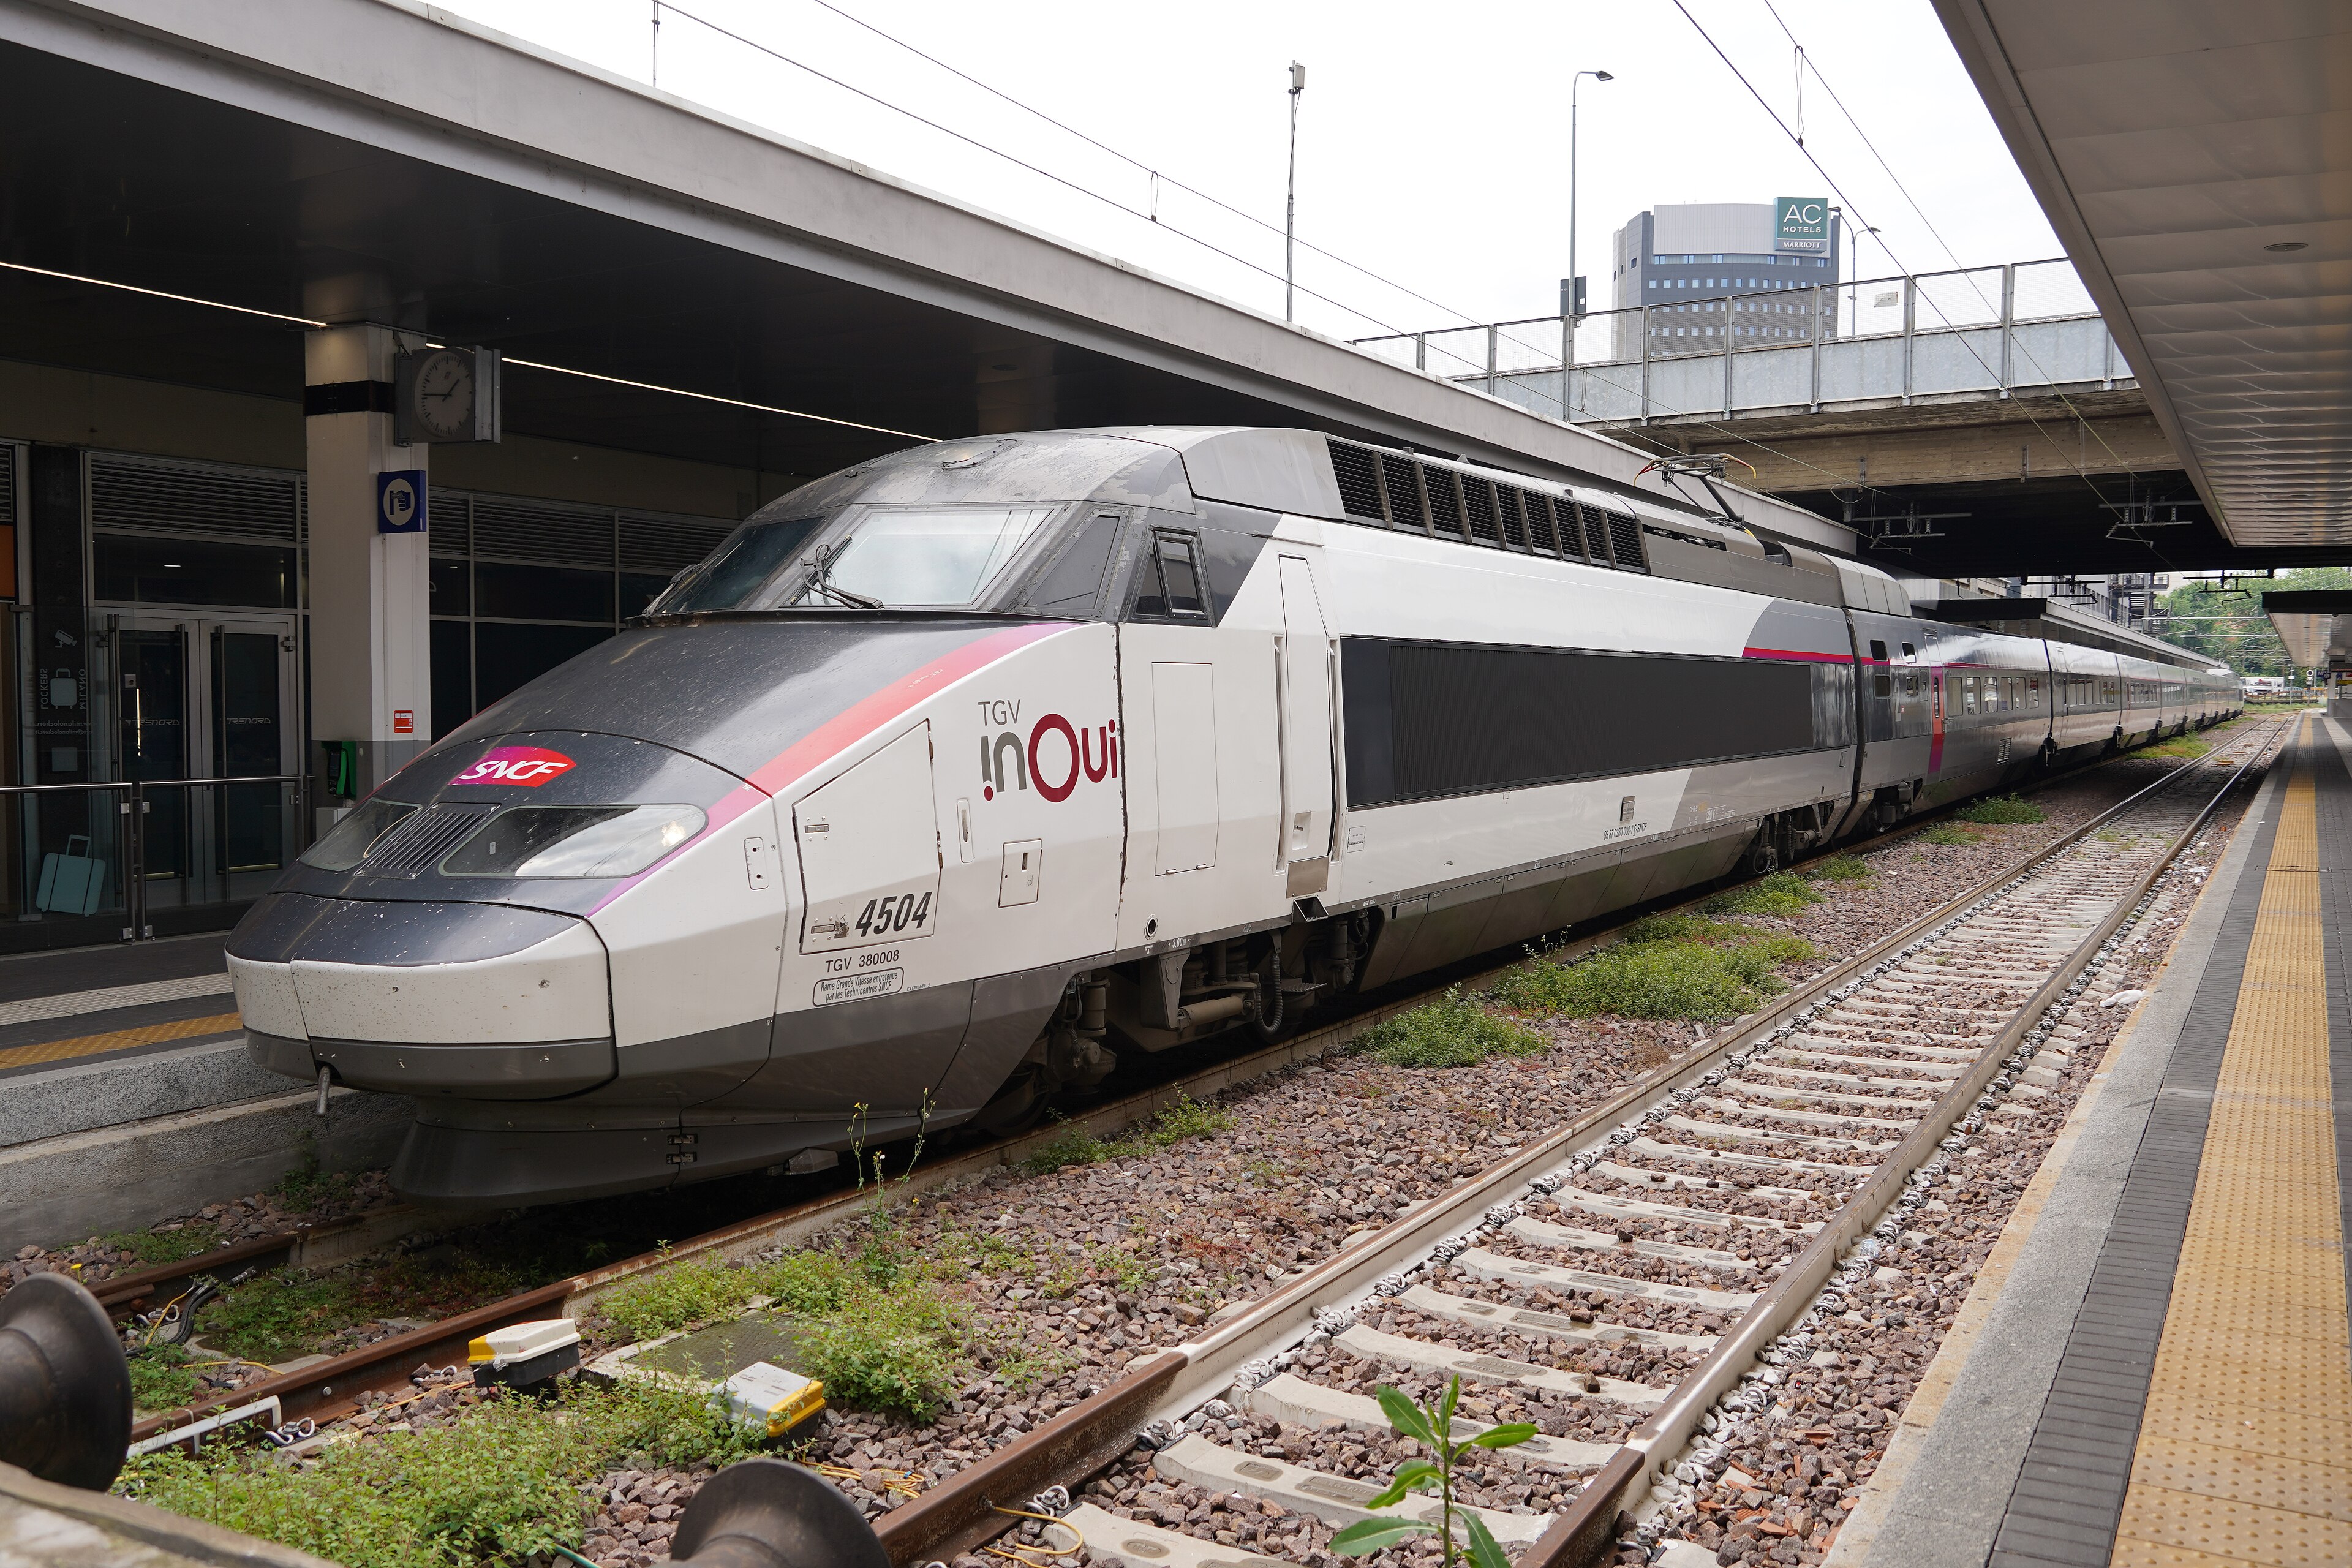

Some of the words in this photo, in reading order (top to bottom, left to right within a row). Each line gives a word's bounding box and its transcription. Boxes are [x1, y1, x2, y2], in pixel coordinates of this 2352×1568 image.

[1783, 204, 1822, 224] AC
[978, 699, 1020, 726] TGV
[458, 760, 568, 780] SNCF
[854, 891, 933, 937] 4504
[1172, 937, 1186, 948] 3.00m
[825, 957, 852, 972] TGV
[858, 949, 899, 968] 380008
[821, 982, 835, 992] Rame
[835, 978, 854, 990] Grande
[855, 976, 872, 986] Vitesse
[873, 971, 898, 982] entretenue
[826, 993, 834, 1003] par
[844, 984, 877, 998] Technicentres
[878, 980, 892, 992] SNCF
